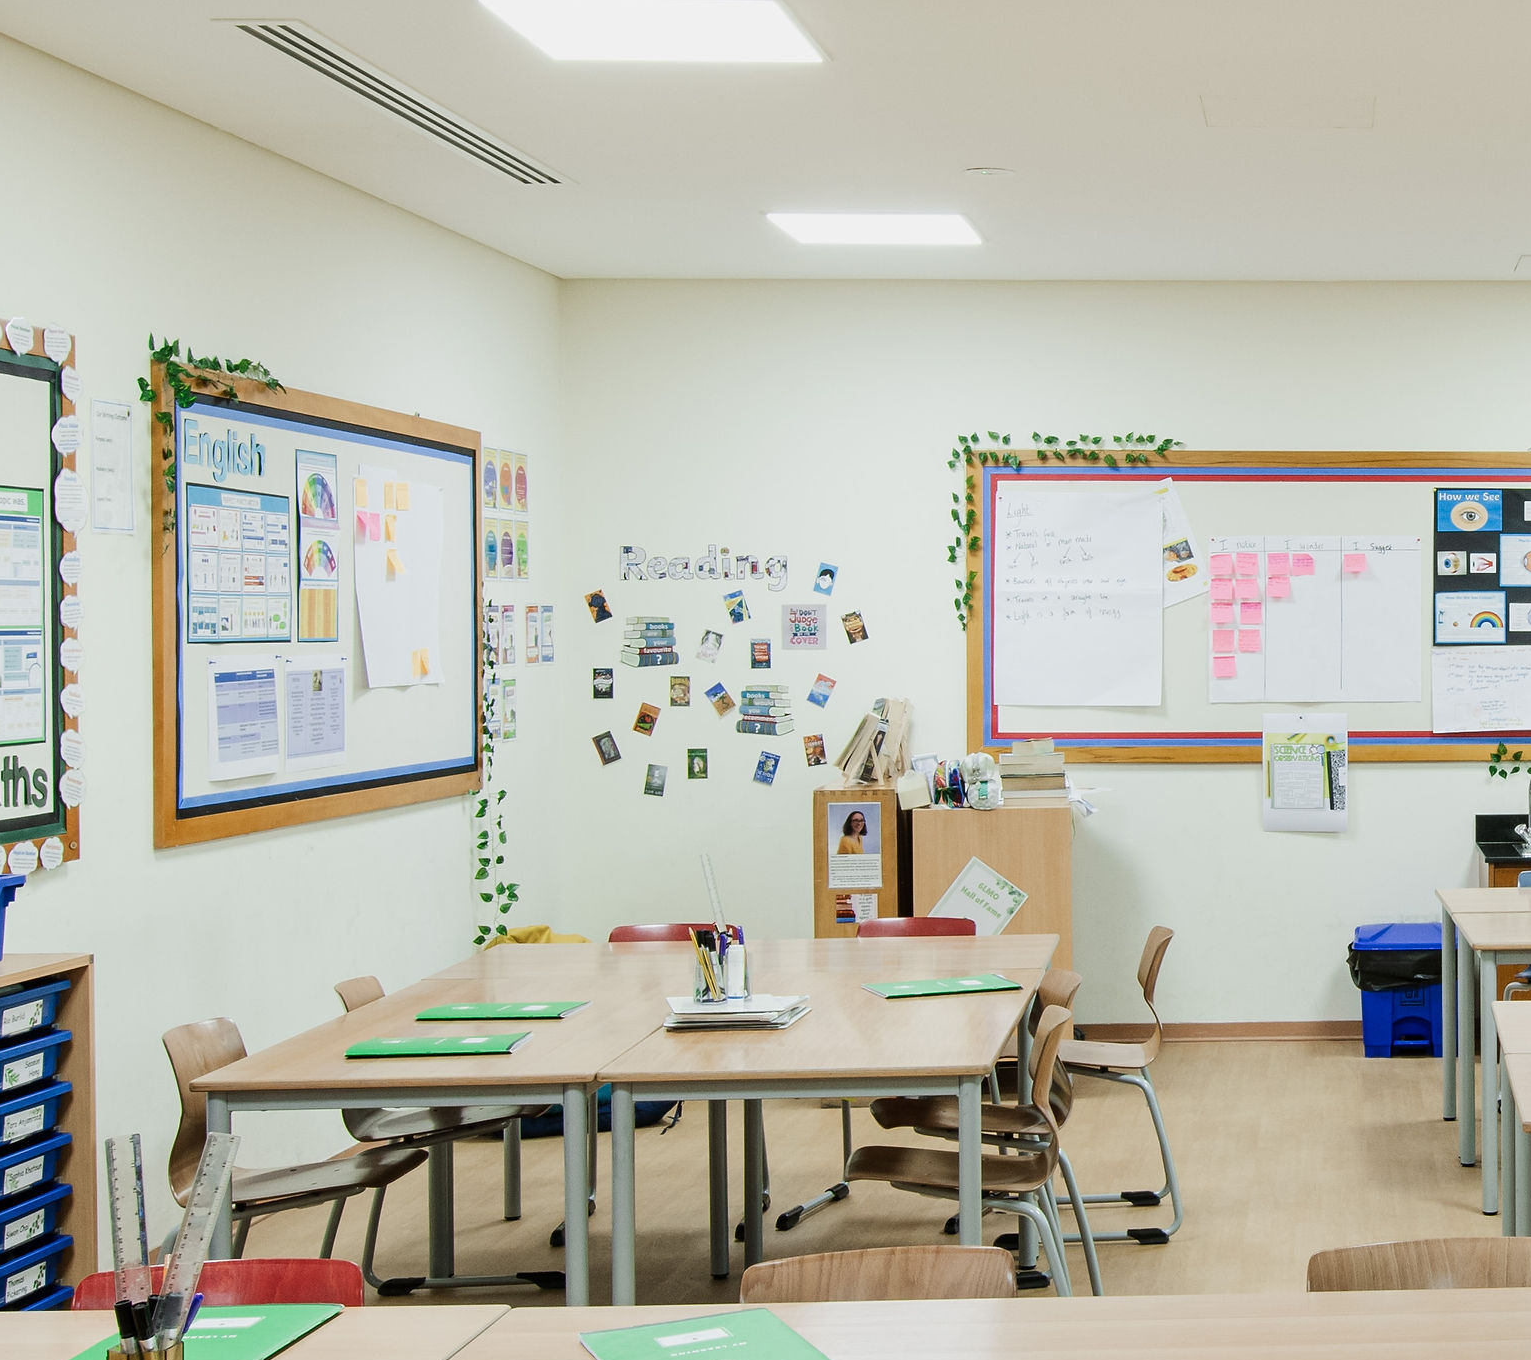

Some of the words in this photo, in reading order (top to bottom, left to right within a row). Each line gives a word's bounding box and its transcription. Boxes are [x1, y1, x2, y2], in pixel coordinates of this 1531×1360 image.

[183, 418, 267, 484] English
[1439, 492, 1462, 501] How
[1483, 492, 1500, 501] See
[1006, 503, 1031, 525] Light
[619, 544, 788, 592] Reading
[794, 624, 818, 632] Book
[790, 637, 819, 645] COVER
[1274, 745, 1306, 754] SCIENCE
[961, 886, 976, 899] Hall
[975, 897, 984, 905] of
[983, 903, 1001, 919] Fame
